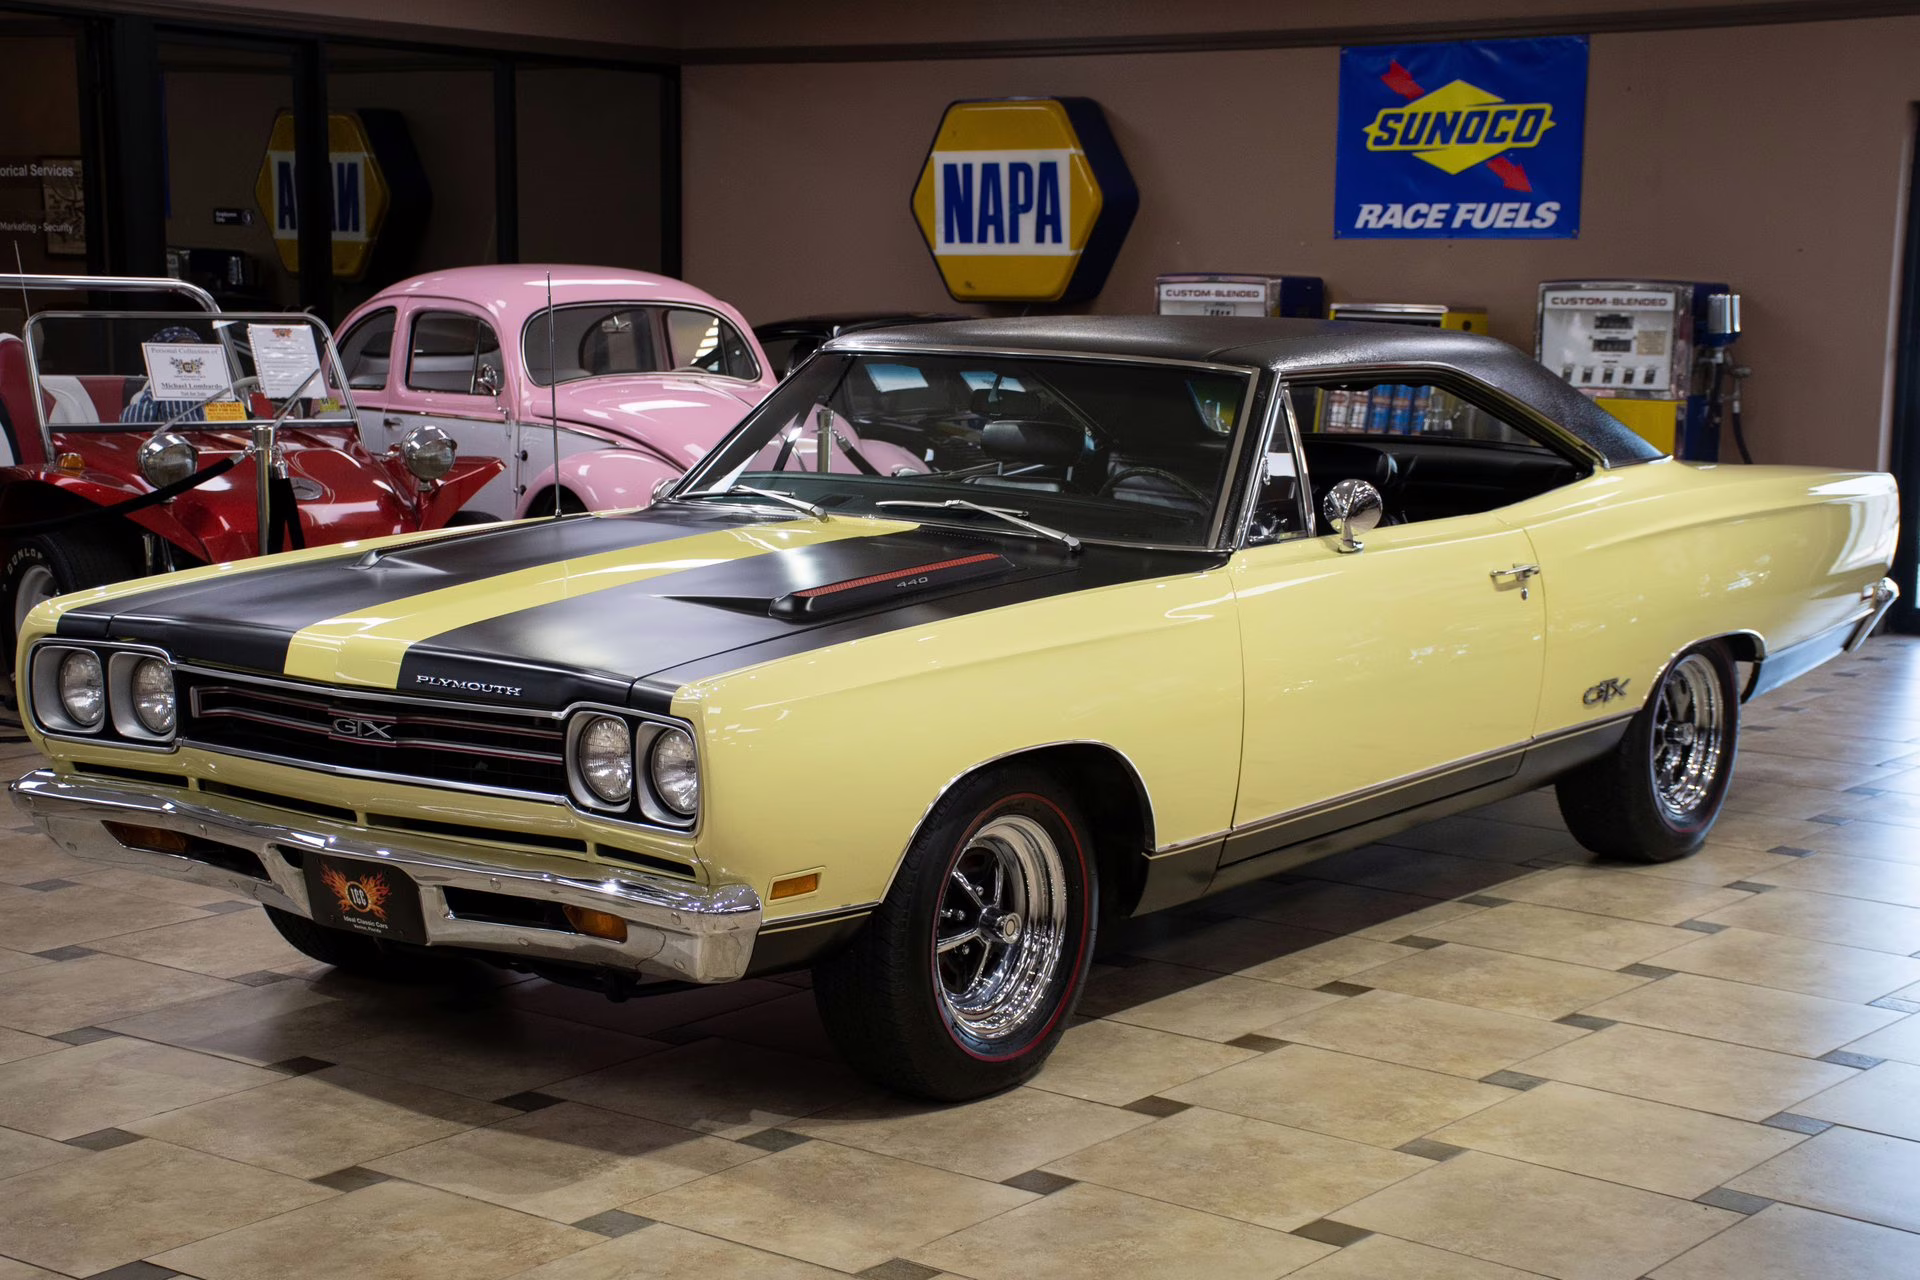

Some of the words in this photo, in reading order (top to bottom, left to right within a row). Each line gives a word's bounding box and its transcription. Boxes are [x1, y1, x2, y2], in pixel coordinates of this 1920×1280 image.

[1373, 107, 1546, 147] SUNOCO
[0, 164, 28, 176] orical
[30, 163, 74, 176] Services
[943, 162, 1063, 244] NAPA
[1354, 202, 1452, 230] RACE
[1451, 200, 1562, 230] FUELS
[0, 222, 36, 234] Marketing
[43, 222, 74, 234] Security
[1165, 287, 1260, 299] CUSTOM-BLENDED
[1551, 295, 1668, 307] CUSTOM-BLENDED
[161, 382, 187, 390] Michael
[7, 547, 43, 575] DUNLOP
[896, 577, 928, 587] 440
[416, 674, 524, 697] PLYMOUTH
[1583, 678, 1631, 705] GTX
[333, 718, 392, 739] GTX
[357, 918, 375, 926] Classic
[376, 921, 388, 929] Cars
